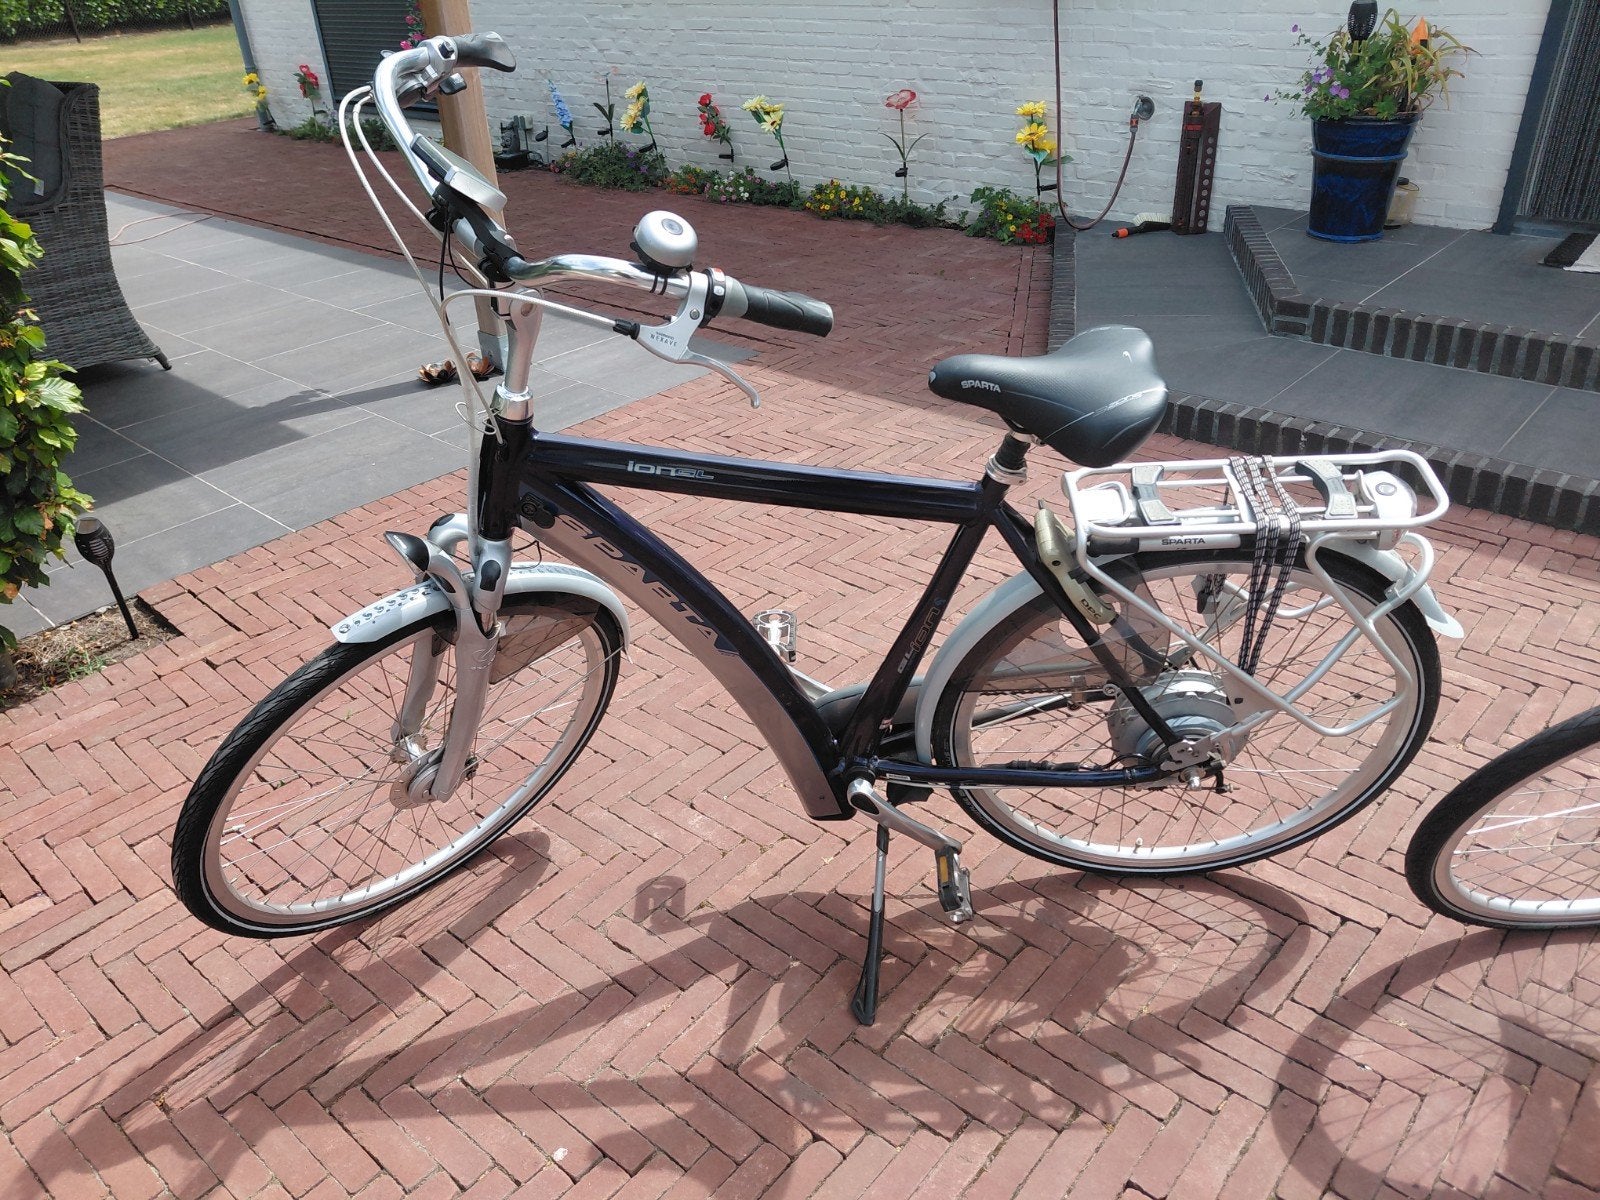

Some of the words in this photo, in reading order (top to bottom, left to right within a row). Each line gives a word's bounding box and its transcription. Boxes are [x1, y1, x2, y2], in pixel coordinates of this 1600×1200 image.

[960, 379, 1001, 392] SPARTA
[1161, 537, 1206, 545] SPARTA
[555, 513, 729, 652] SPARTA
